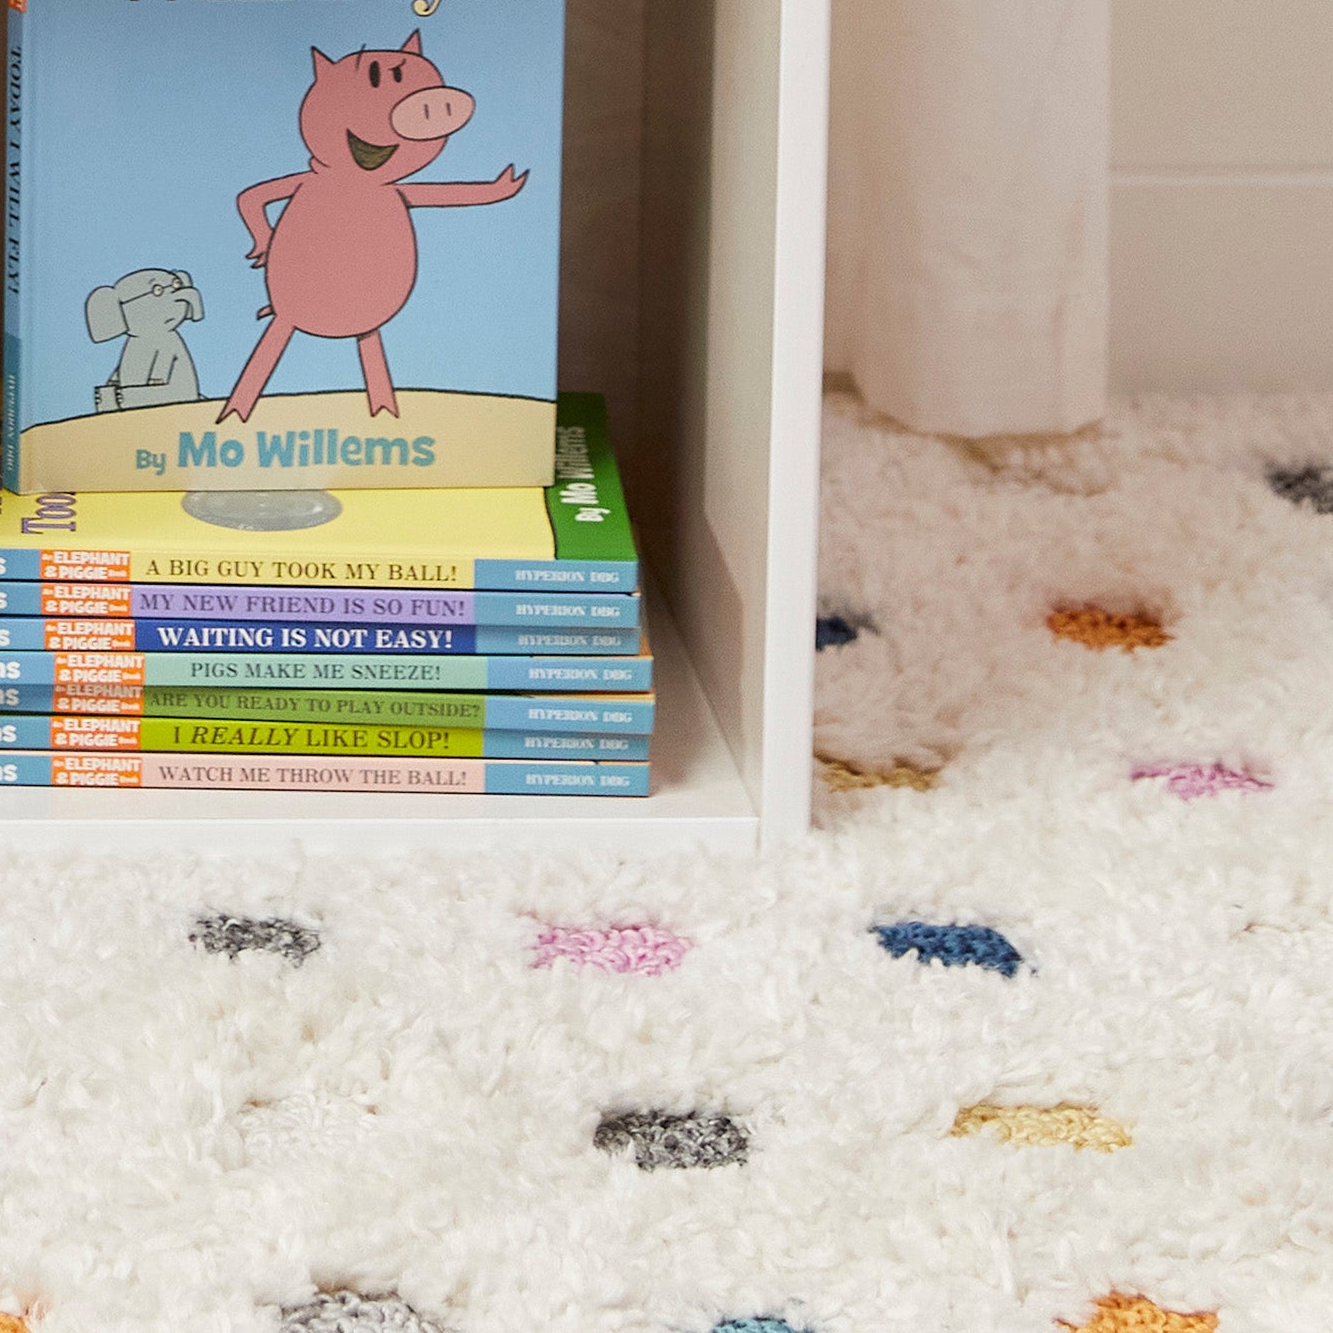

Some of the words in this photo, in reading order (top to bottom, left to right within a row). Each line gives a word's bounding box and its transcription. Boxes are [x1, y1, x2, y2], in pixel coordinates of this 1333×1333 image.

[136, 449, 167, 476] By
[178, 430, 244, 468] Mo
[256, 427, 438, 468] Willems
[145, 559, 160, 576] A
[169, 559, 209, 576] BIG
[217, 560, 264, 578] GUY
[271, 561, 337, 580] TOOK
[345, 563, 380, 580] MY
[388, 564, 456, 581] BALL!
[139, 593, 173, 611] MY
[182, 594, 238, 612] NEW
[246, 595, 335, 614] FRIEND
[343, 597, 365, 615] IS
[372, 598, 403, 616] SO
[411, 599, 465, 617] FUN!
[157, 627, 273, 647] WAITING
[281, 628, 307, 648] IS
[314, 629, 368, 648] NOT
[375, 629, 452, 649] EASY!
[191, 662, 238, 678] PIGS
[244, 662, 306, 679] MAKE
[312, 663, 345, 680] ME
[351, 664, 441, 681] SNEEZE!
[150, 692, 188, 707] ARE
[193, 694, 229, 709] YOU
[237, 696, 301, 712] READY
[306, 698, 331, 714] TO
[337, 699, 384, 715] PLAY
[390, 702, 480, 719] OUTSIDE?
[174, 726, 180, 744] I
[189, 726, 300, 746] REALLY
[306, 728, 368, 748] LIKE
[377, 729, 450, 750] SLOP!
[158, 765, 233, 782] WATCH
[239, 767, 271, 783] ME
[275, 767, 354, 784] THROW
[359, 769, 401, 785] THE
[407, 770, 467, 786] BALL!
